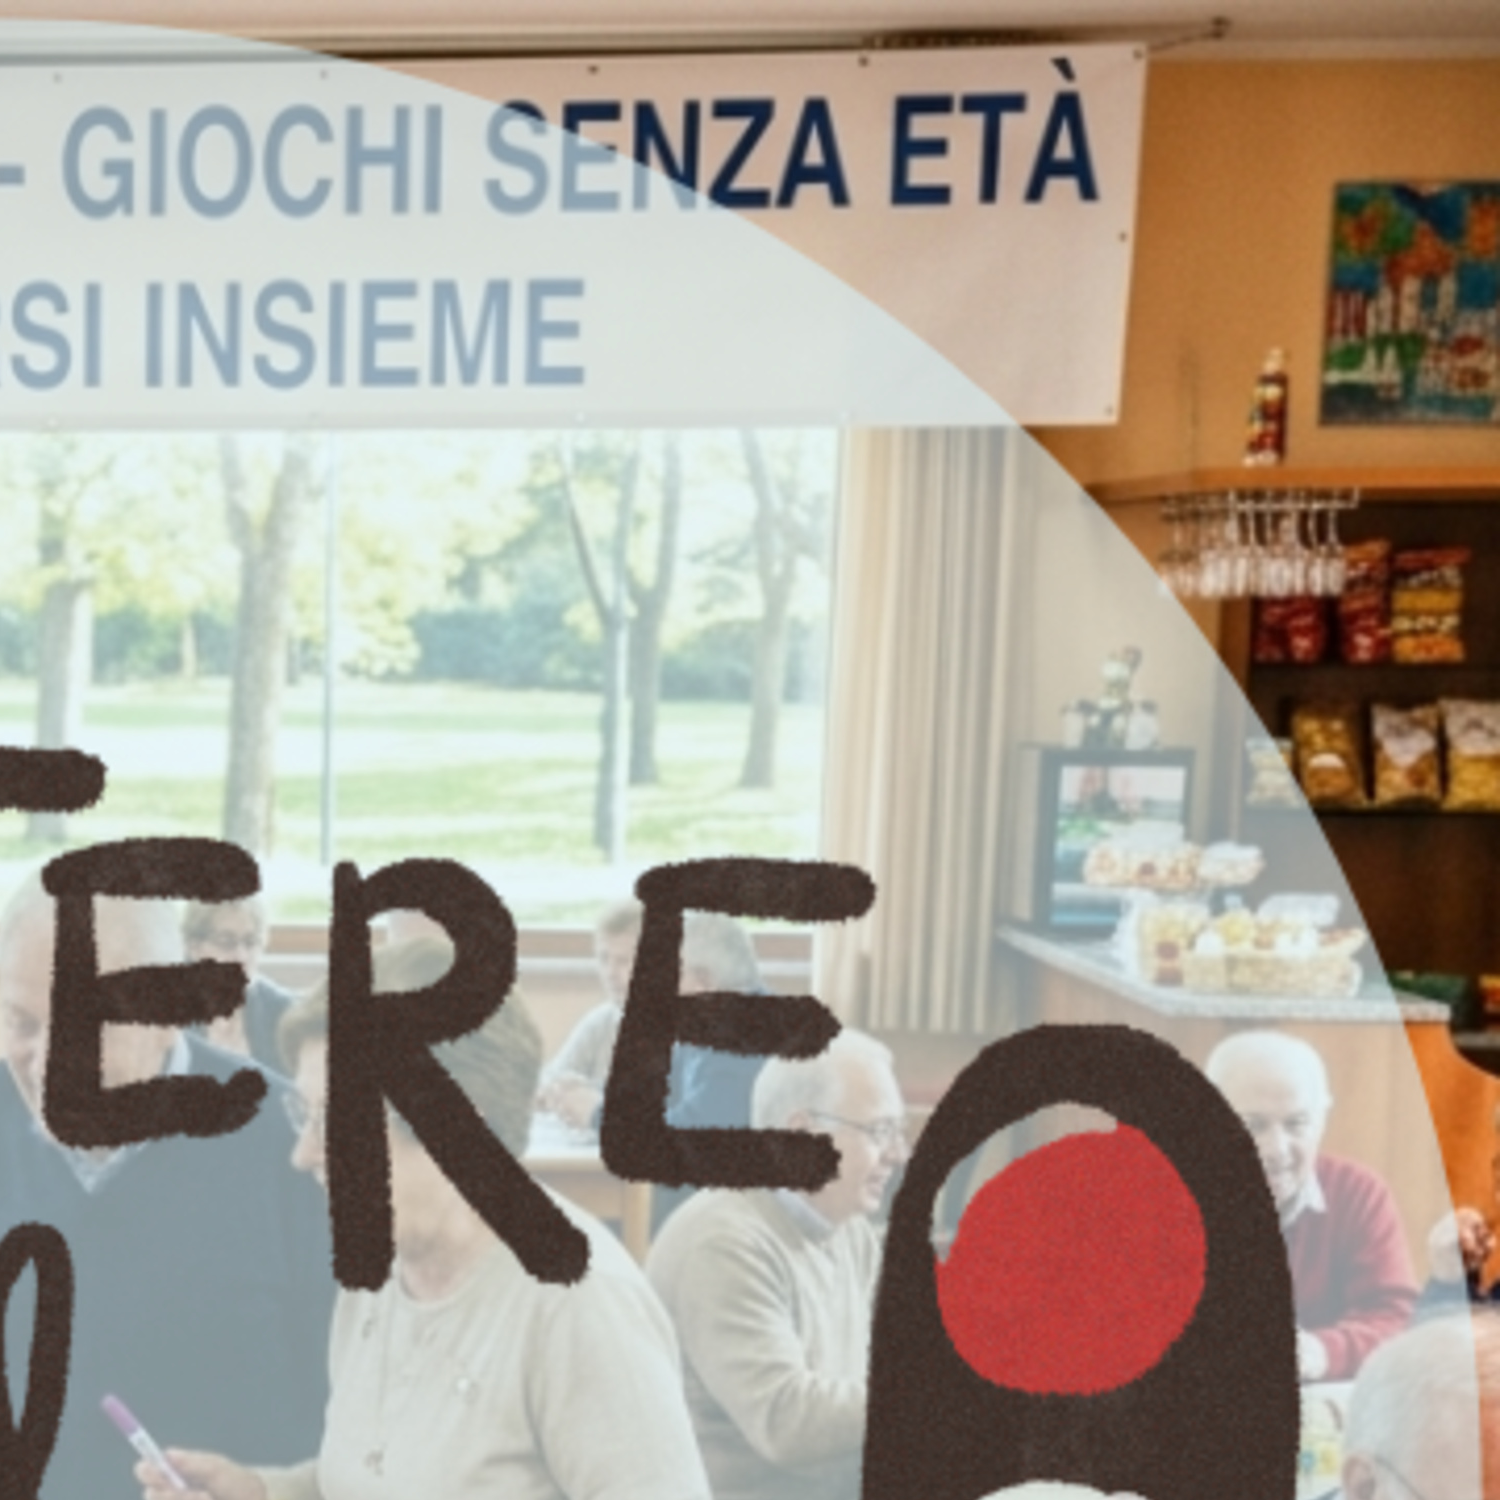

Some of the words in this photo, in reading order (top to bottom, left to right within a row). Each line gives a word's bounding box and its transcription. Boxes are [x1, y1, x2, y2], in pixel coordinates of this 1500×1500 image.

[60, 104, 444, 219] GIOCHI
[482, 96, 852, 217] SENZA
[888, 57, 1100, 206] ETÀ
[144, 278, 587, 390] INSIEME
